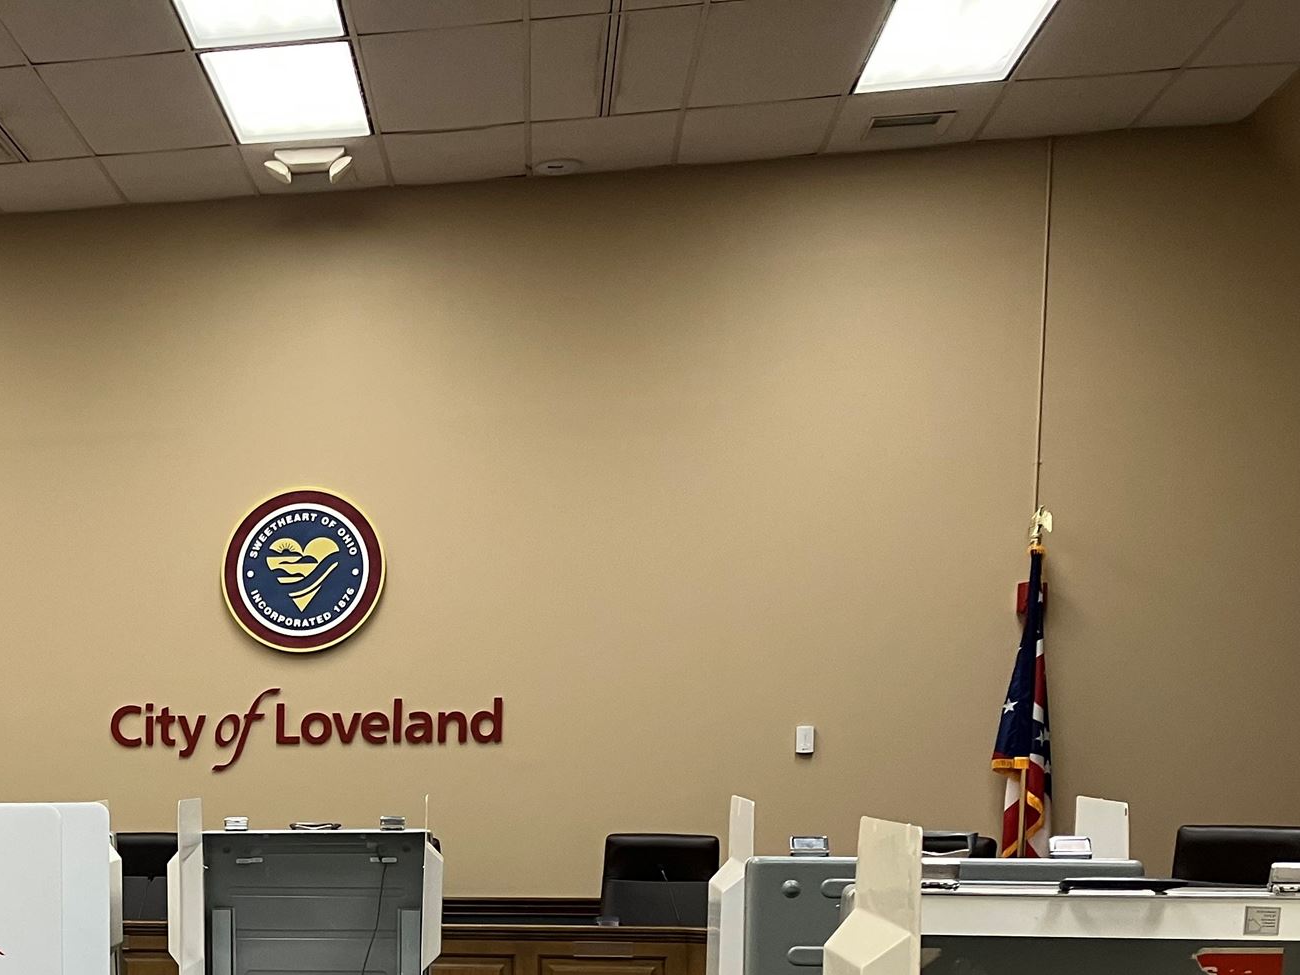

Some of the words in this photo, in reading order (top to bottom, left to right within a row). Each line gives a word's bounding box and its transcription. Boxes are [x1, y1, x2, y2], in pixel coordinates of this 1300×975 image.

[249, 512, 318, 559] SWEETHEART
[321, 516, 337, 528] OF
[337, 527, 358, 556] OHIO
[250, 589, 332, 628] INCORPORATED
[333, 587, 355, 613] 1876
[110, 703, 206, 759] City
[212, 688, 281, 773] of
[276, 697, 503, 744] Loveland
